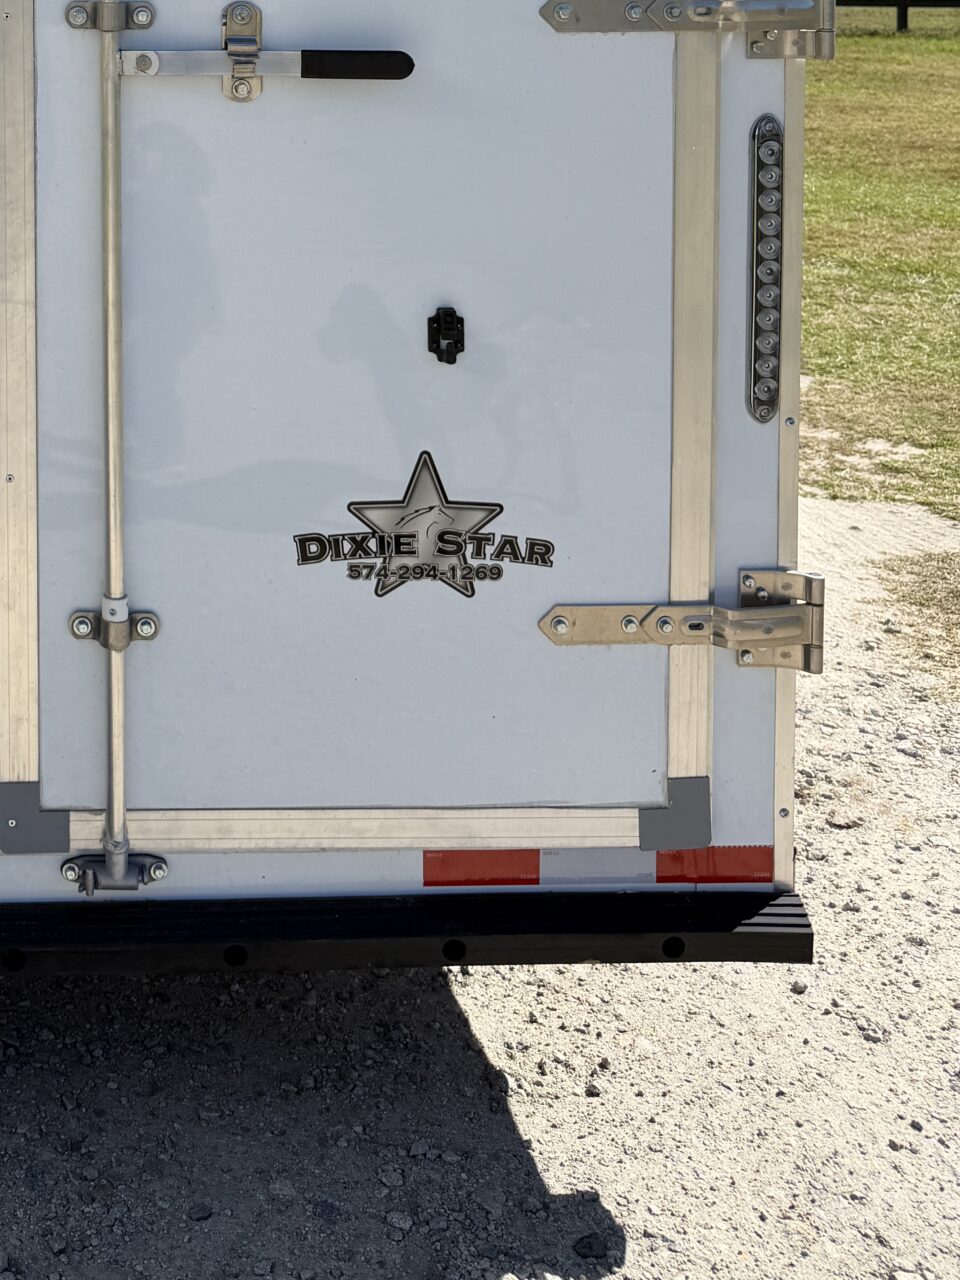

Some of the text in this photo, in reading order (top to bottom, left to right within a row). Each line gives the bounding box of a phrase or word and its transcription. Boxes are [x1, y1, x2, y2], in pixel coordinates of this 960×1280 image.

[293, 529, 555, 568] DIXIE STAR
[346, 562, 504, 582] 574-294-1269
